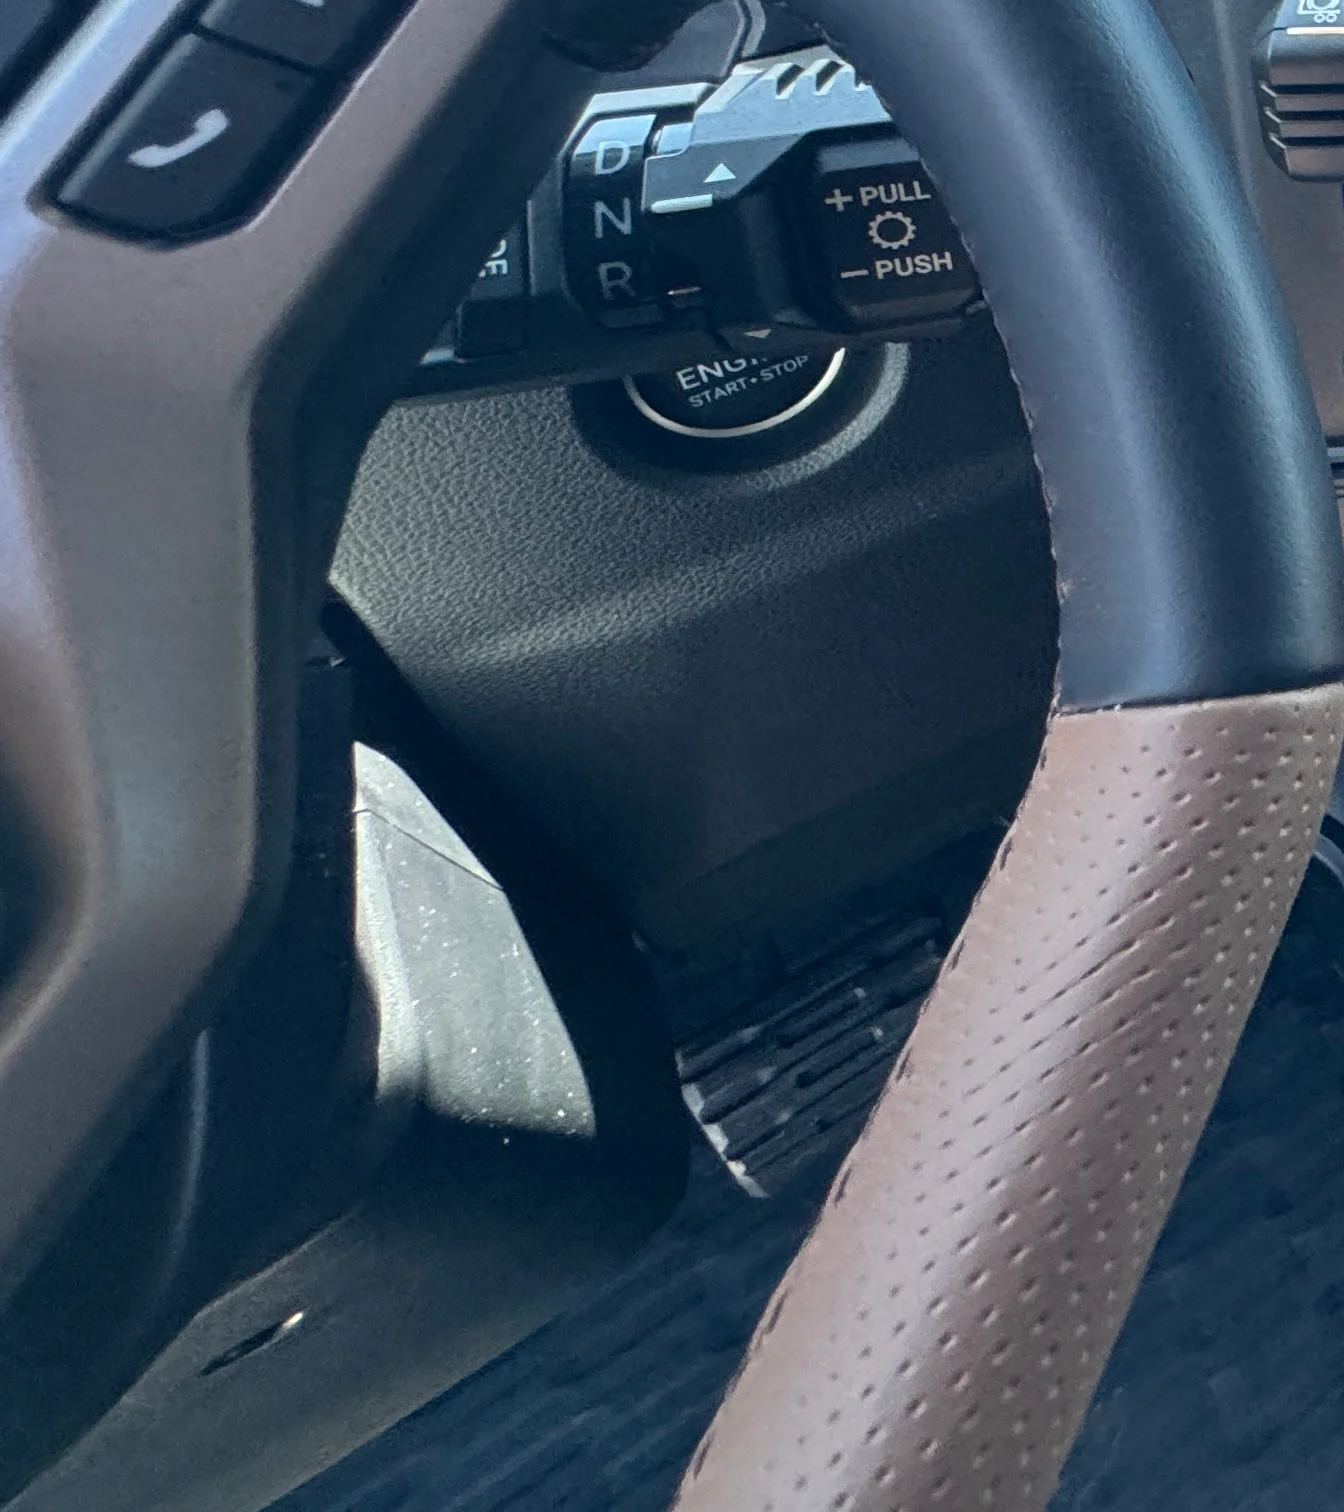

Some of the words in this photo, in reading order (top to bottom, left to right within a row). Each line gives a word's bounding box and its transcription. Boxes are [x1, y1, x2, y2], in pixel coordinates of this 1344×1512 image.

[594, 140, 632, 175] D
[594, 197, 632, 238] N
[597, 260, 637, 300] R
[676, 357, 768, 391] ENG
